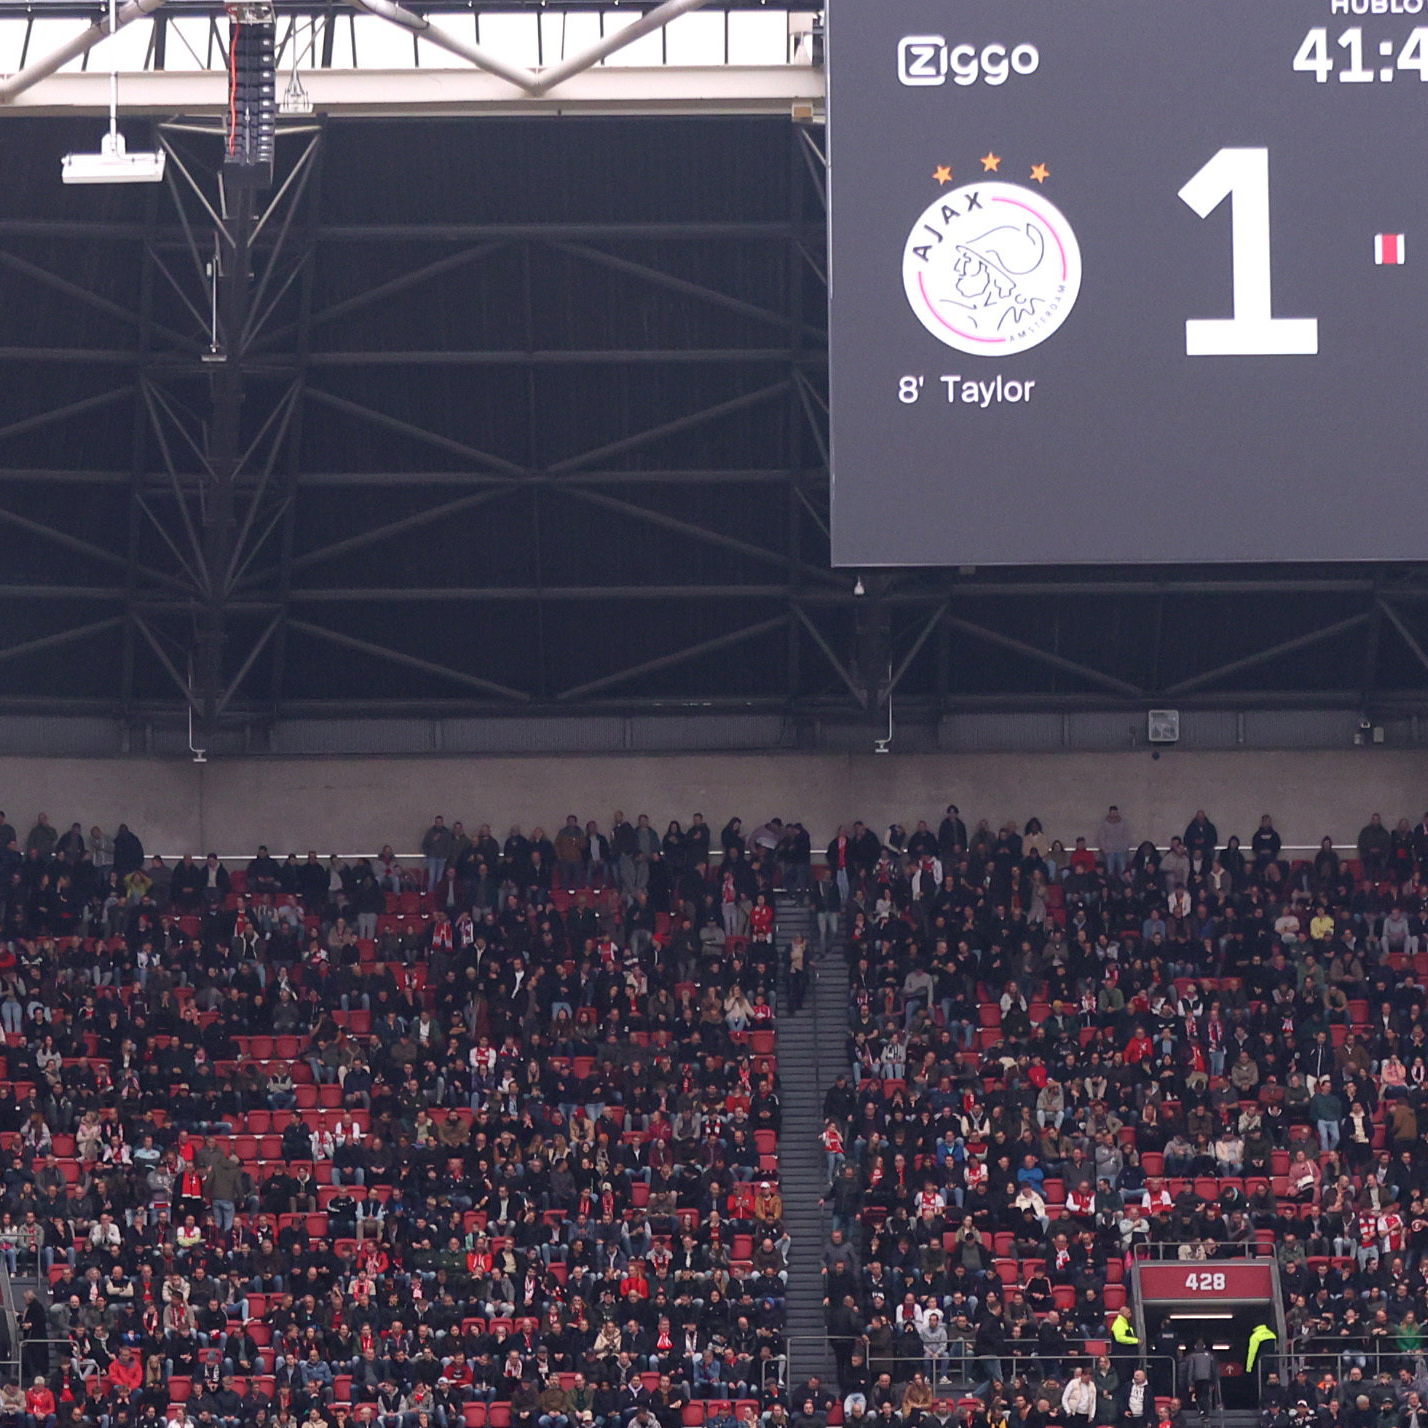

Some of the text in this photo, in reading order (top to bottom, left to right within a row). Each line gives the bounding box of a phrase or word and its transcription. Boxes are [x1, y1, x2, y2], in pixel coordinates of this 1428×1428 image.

[912, 191, 983, 262] AJAX
[1177, 147, 1318, 356] 1
[940, 374, 1036, 409] Taylor
[1185, 1273, 1227, 1291] 428
